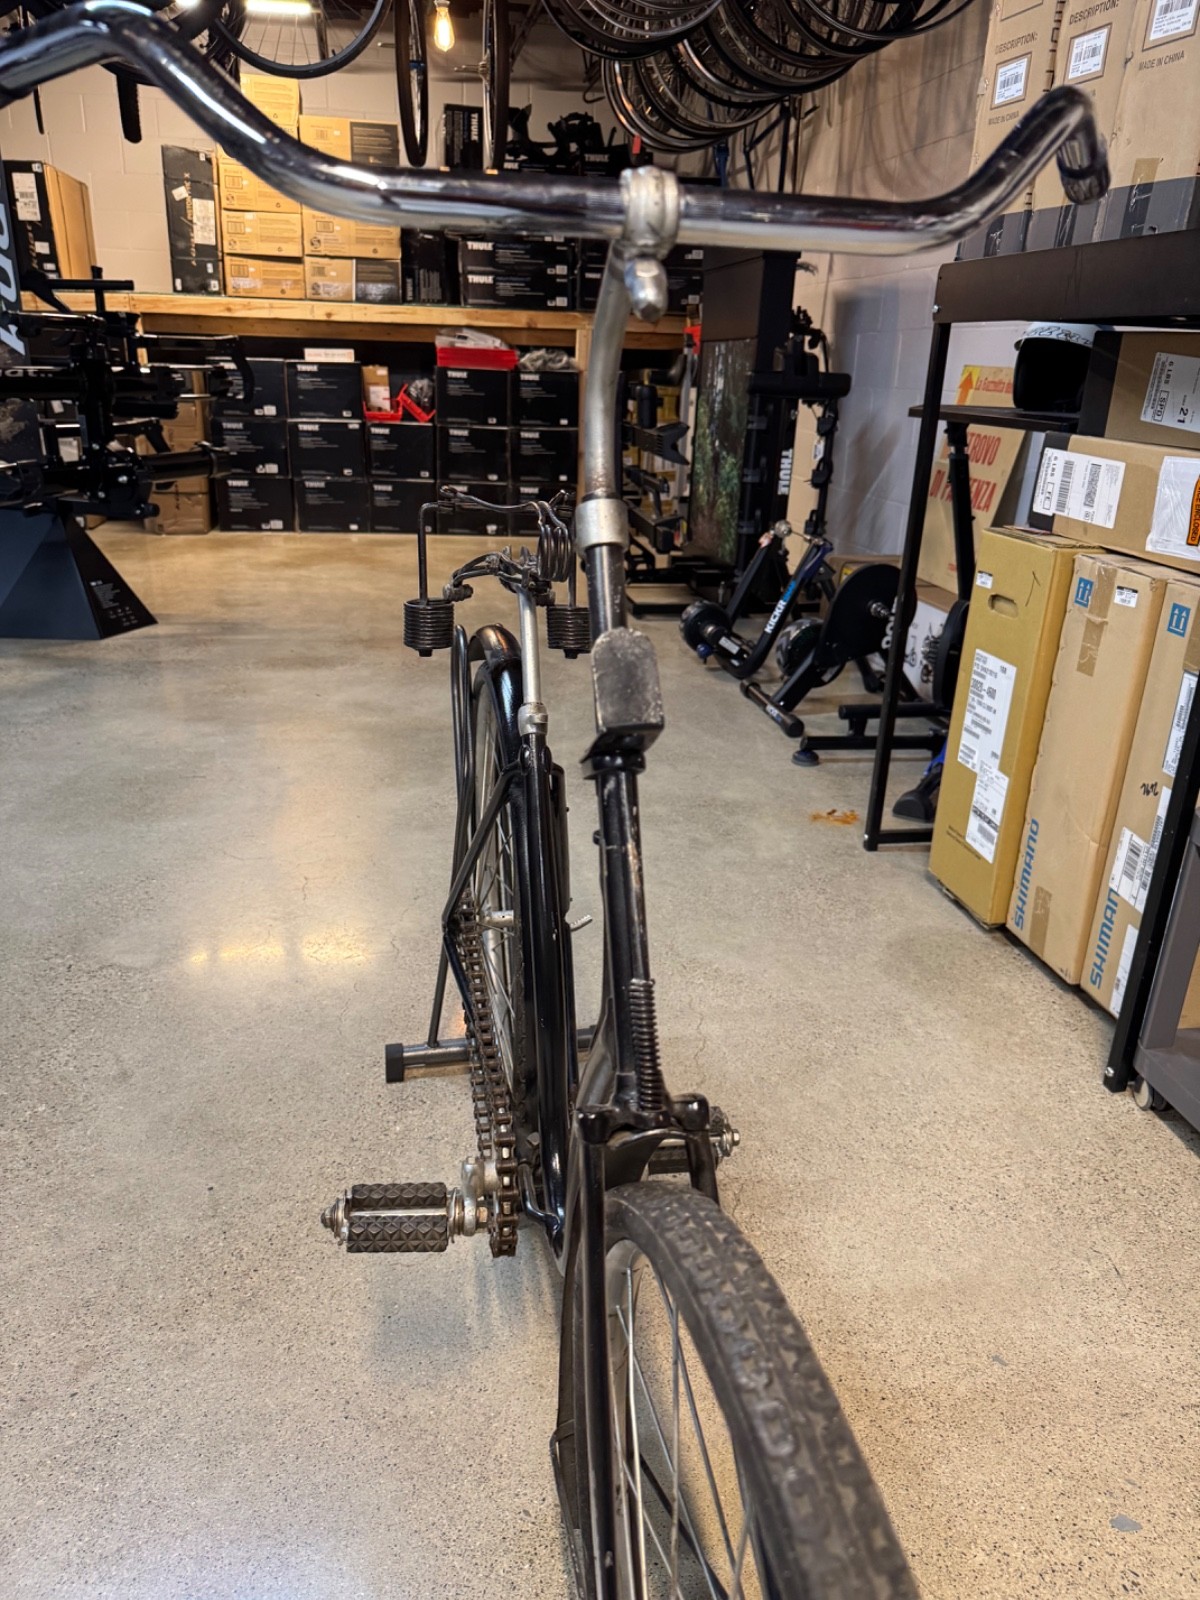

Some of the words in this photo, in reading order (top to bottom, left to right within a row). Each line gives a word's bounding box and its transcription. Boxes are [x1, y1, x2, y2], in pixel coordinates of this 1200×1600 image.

[995, 32, 1038, 55] DESCRIPTION:
[1139, 59, 1156, 71] MADE
[1164, 50, 1185, 64] CHINA
[470, 108, 479, 141] THULE
[584, 153, 609, 163] THULE
[467, 242, 494, 251] THULE
[467, 275, 494, 284] THULE
[297, 364, 318, 372] THULE
[447, 371, 468, 379] THULE
[222, 422, 244, 430] THULE
[298, 424, 320, 432] THULE
[370, 427, 390, 435] THULE
[449, 429, 469, 437] THULE
[777, 448, 793, 495] THULE
[764, 600, 787, 634] KICKR
[1014, 818, 1039, 931] SHIMANO
[1089, 887, 1120, 989] SHIMAN
